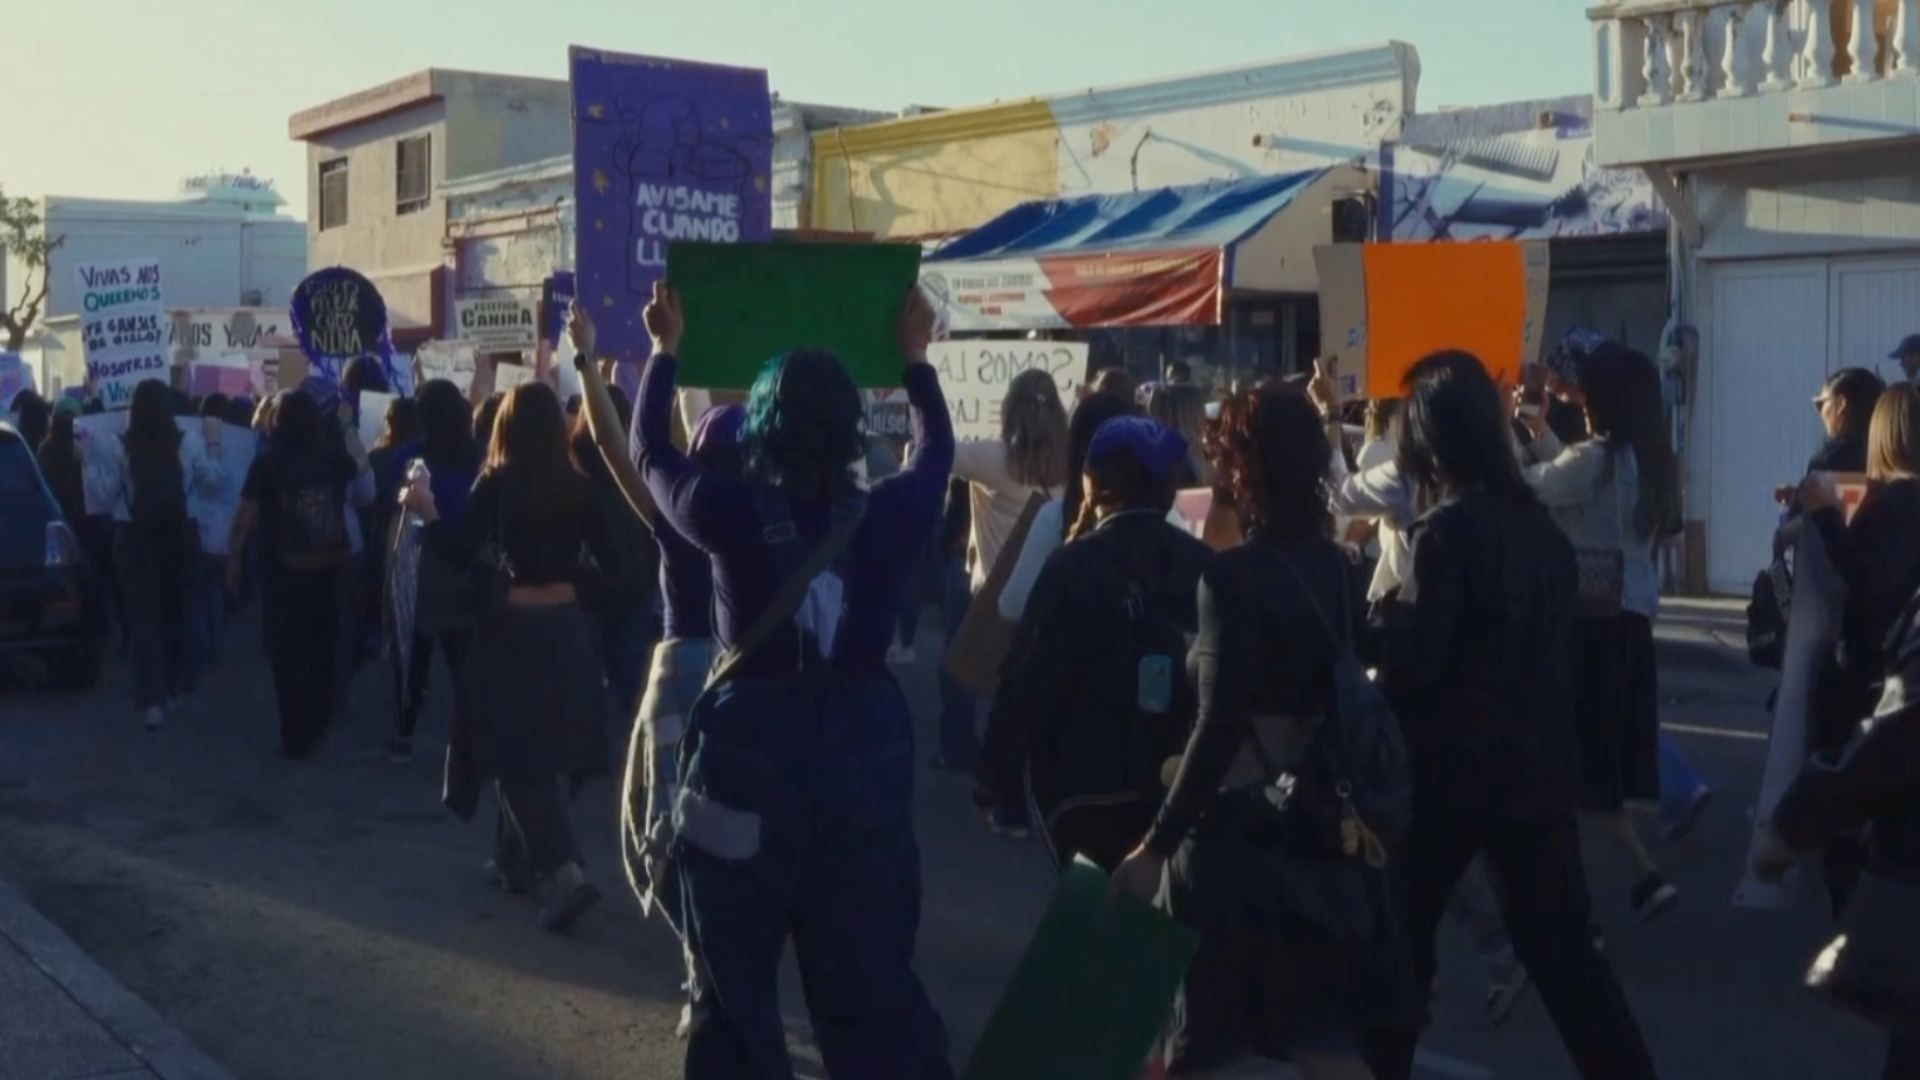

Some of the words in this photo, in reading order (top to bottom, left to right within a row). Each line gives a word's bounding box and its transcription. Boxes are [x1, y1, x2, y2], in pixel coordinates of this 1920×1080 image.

[637, 184, 738, 217] AVISAME
[642, 209, 739, 243] CUANDO
[636, 238, 667, 267] LL
[80, 265, 132, 288] VIVAS
[84, 287, 160, 312] QUEREMOS
[461, 309, 532, 328] CANINA
